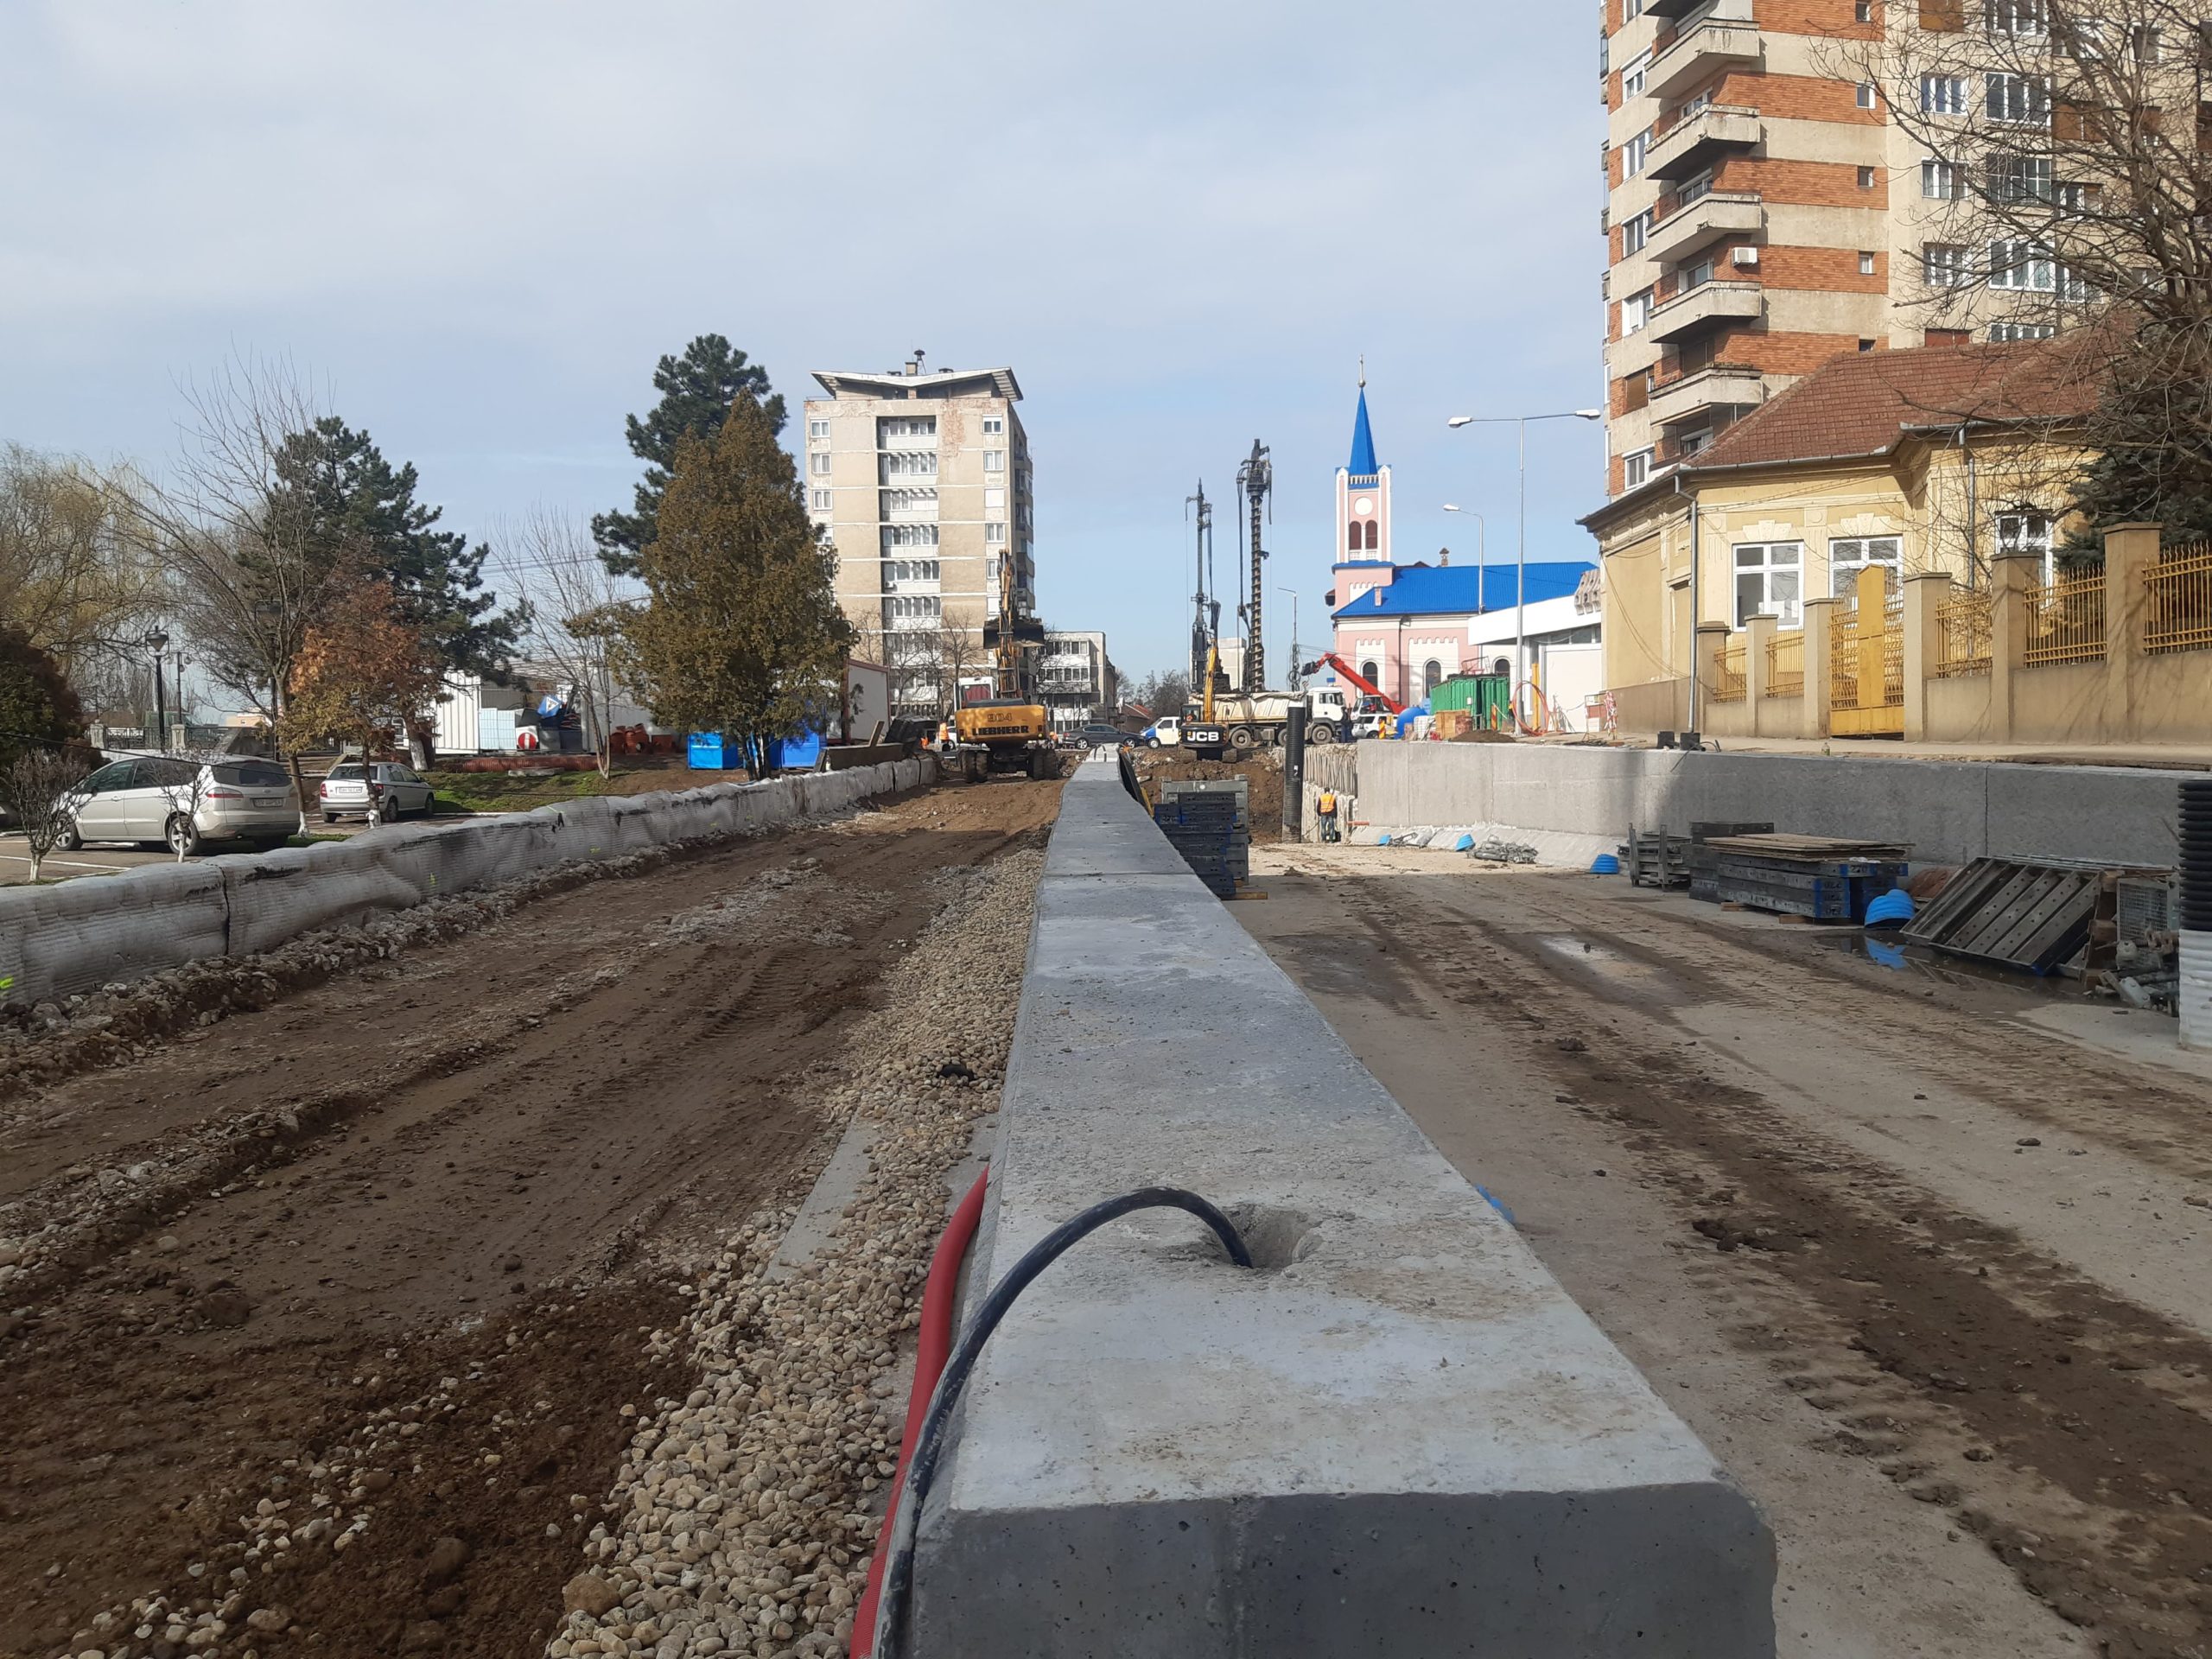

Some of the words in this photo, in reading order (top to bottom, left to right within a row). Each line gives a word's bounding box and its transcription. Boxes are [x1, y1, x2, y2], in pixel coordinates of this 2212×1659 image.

[988, 713, 1013, 722] 904
[972, 725, 1029, 736] LIEBHERR
[1186, 731, 1219, 741] JCB
